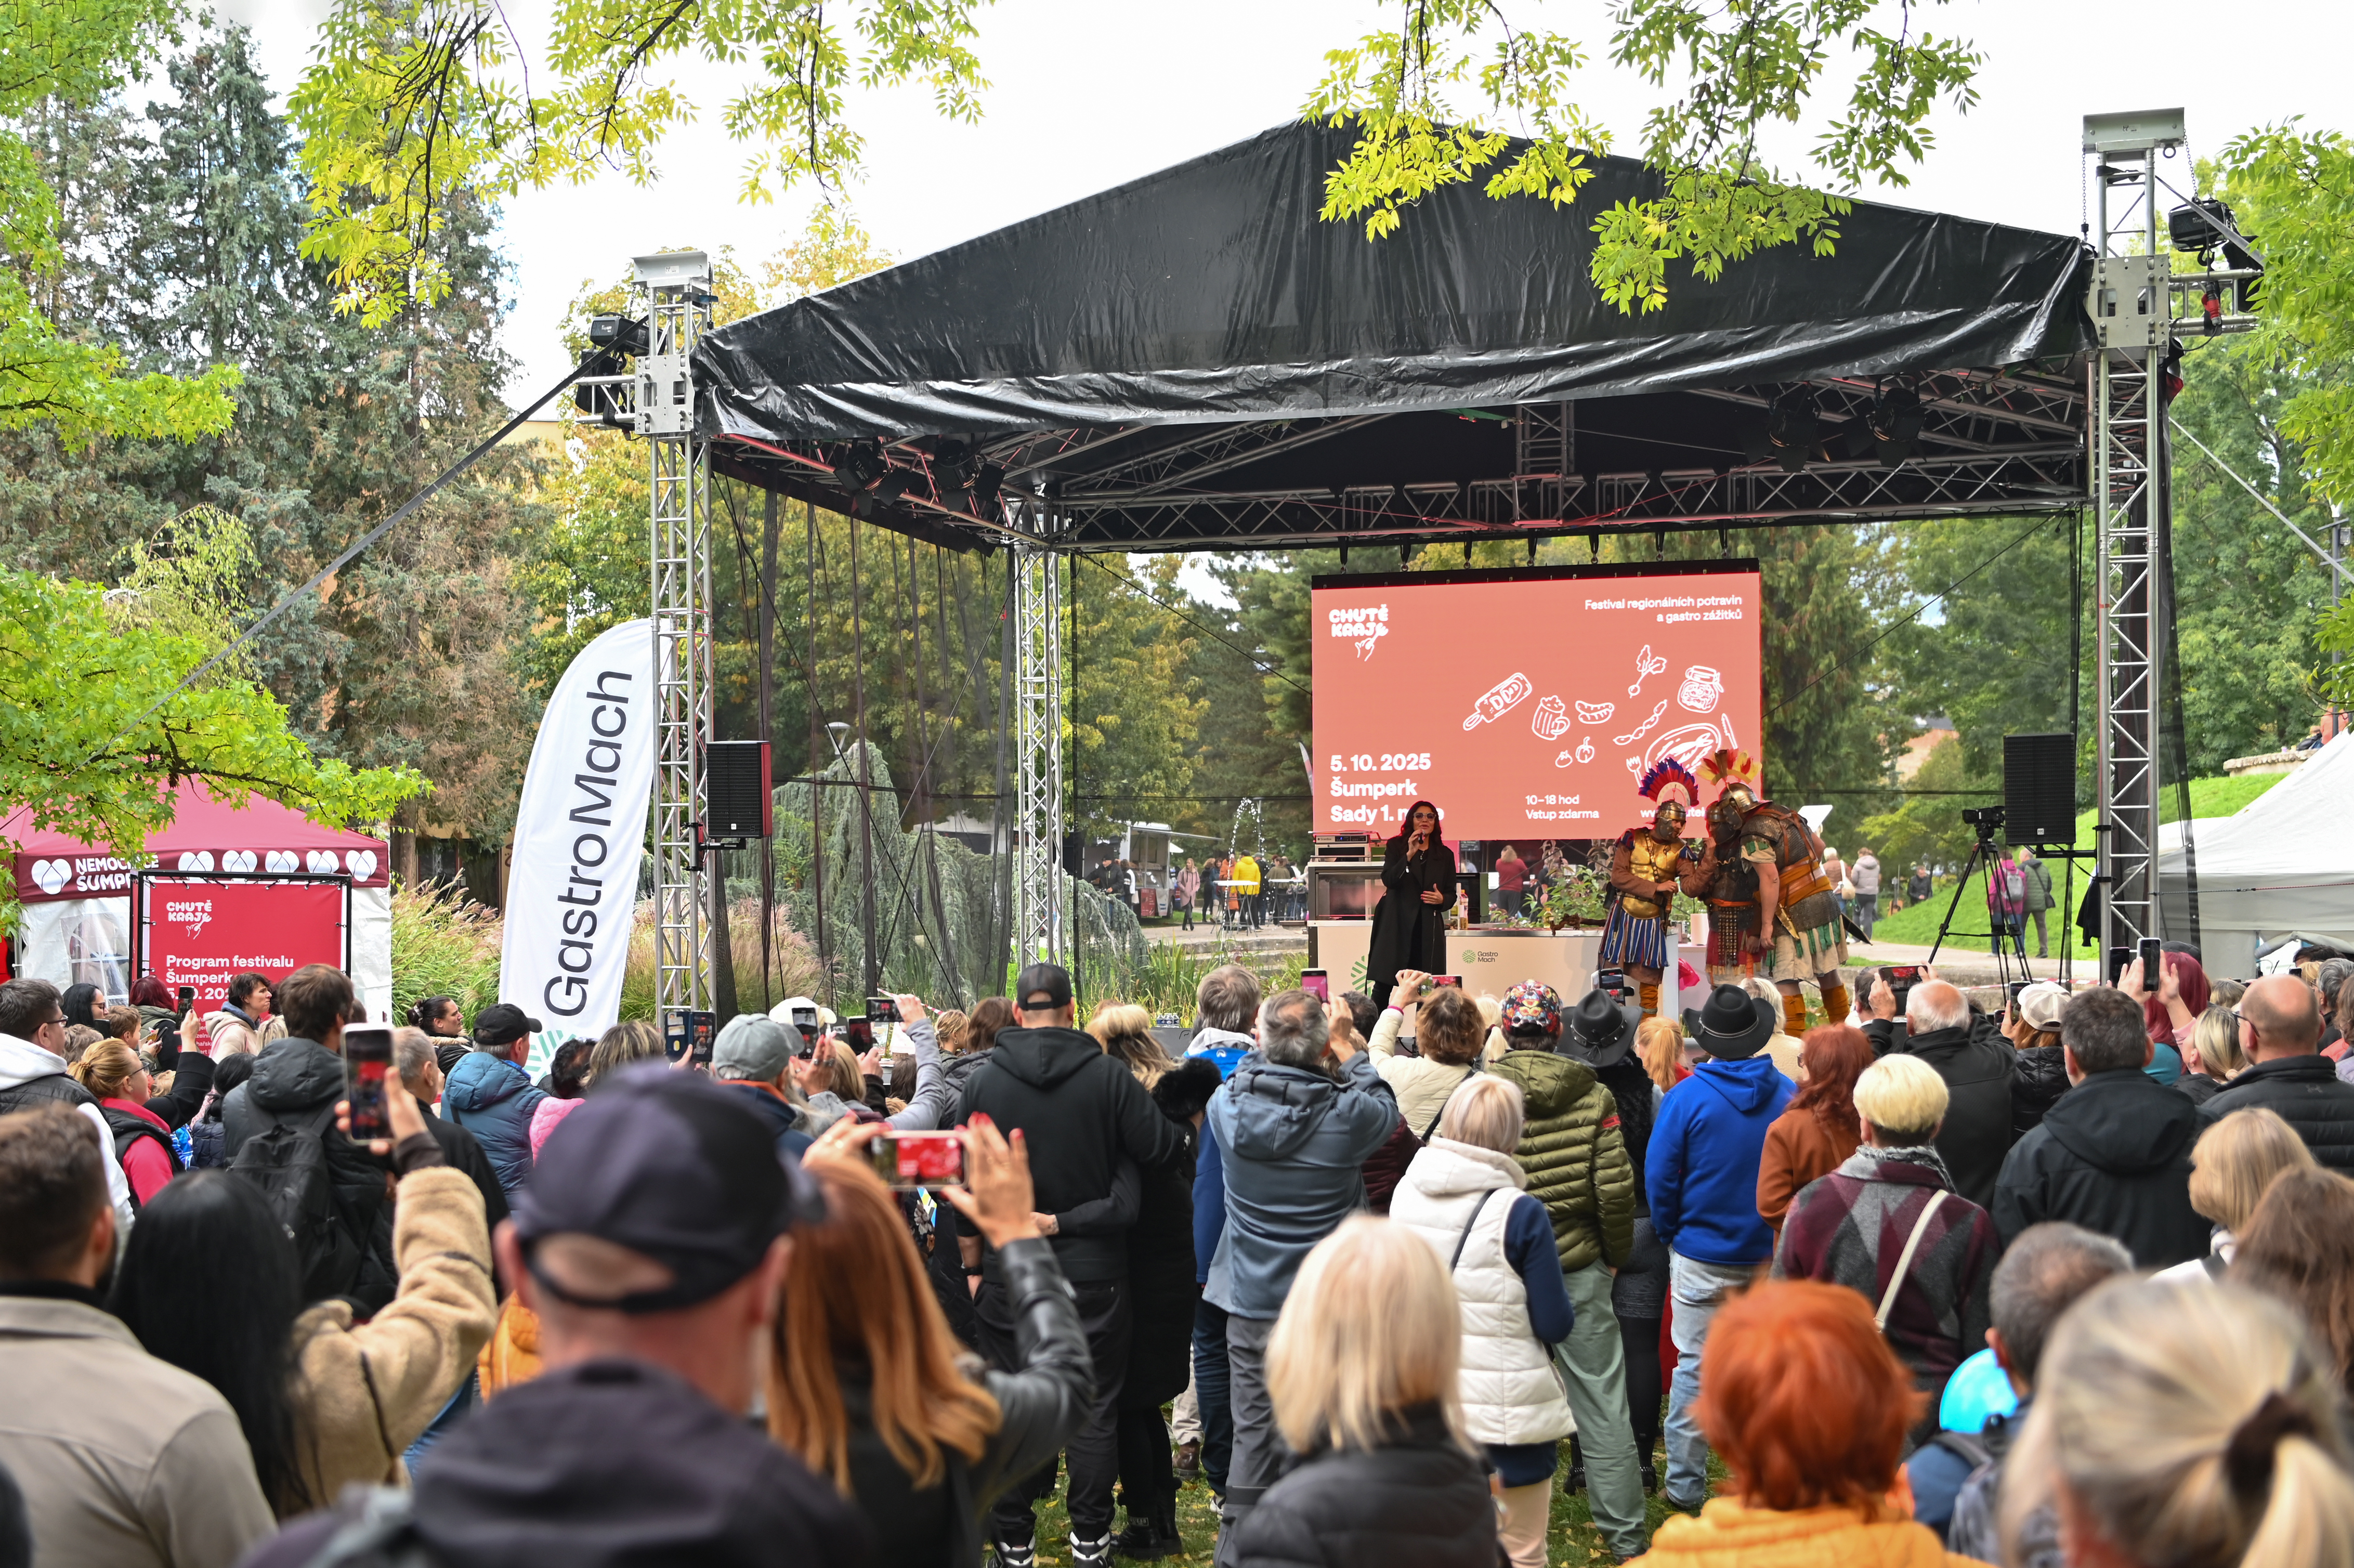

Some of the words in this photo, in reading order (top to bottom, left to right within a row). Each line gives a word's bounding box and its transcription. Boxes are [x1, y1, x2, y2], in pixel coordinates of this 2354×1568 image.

[1585, 599, 1625, 610] Festival
[1627, 596, 1694, 610] regionálních
[1697, 595, 1742, 608] potravin
[1329, 604, 1388, 623] CHUTĚ
[1666, 612, 1701, 624] gastro
[1703, 608, 1742, 620] zážitků
[1380, 753, 1431, 770] 2025
[1330, 776, 1418, 800] Šumperk
[1558, 794, 1579, 805] hod
[1330, 804, 1378, 826] Sady
[1380, 804, 1394, 821] 1.
[1525, 809, 1557, 821] Vstup
[1558, 808, 1600, 819] zdarma
[166, 899, 212, 912] CHUTĚ
[166, 955, 230, 970] Program
[232, 955, 294, 967] festivalu
[166, 969, 233, 986] Šumperk
